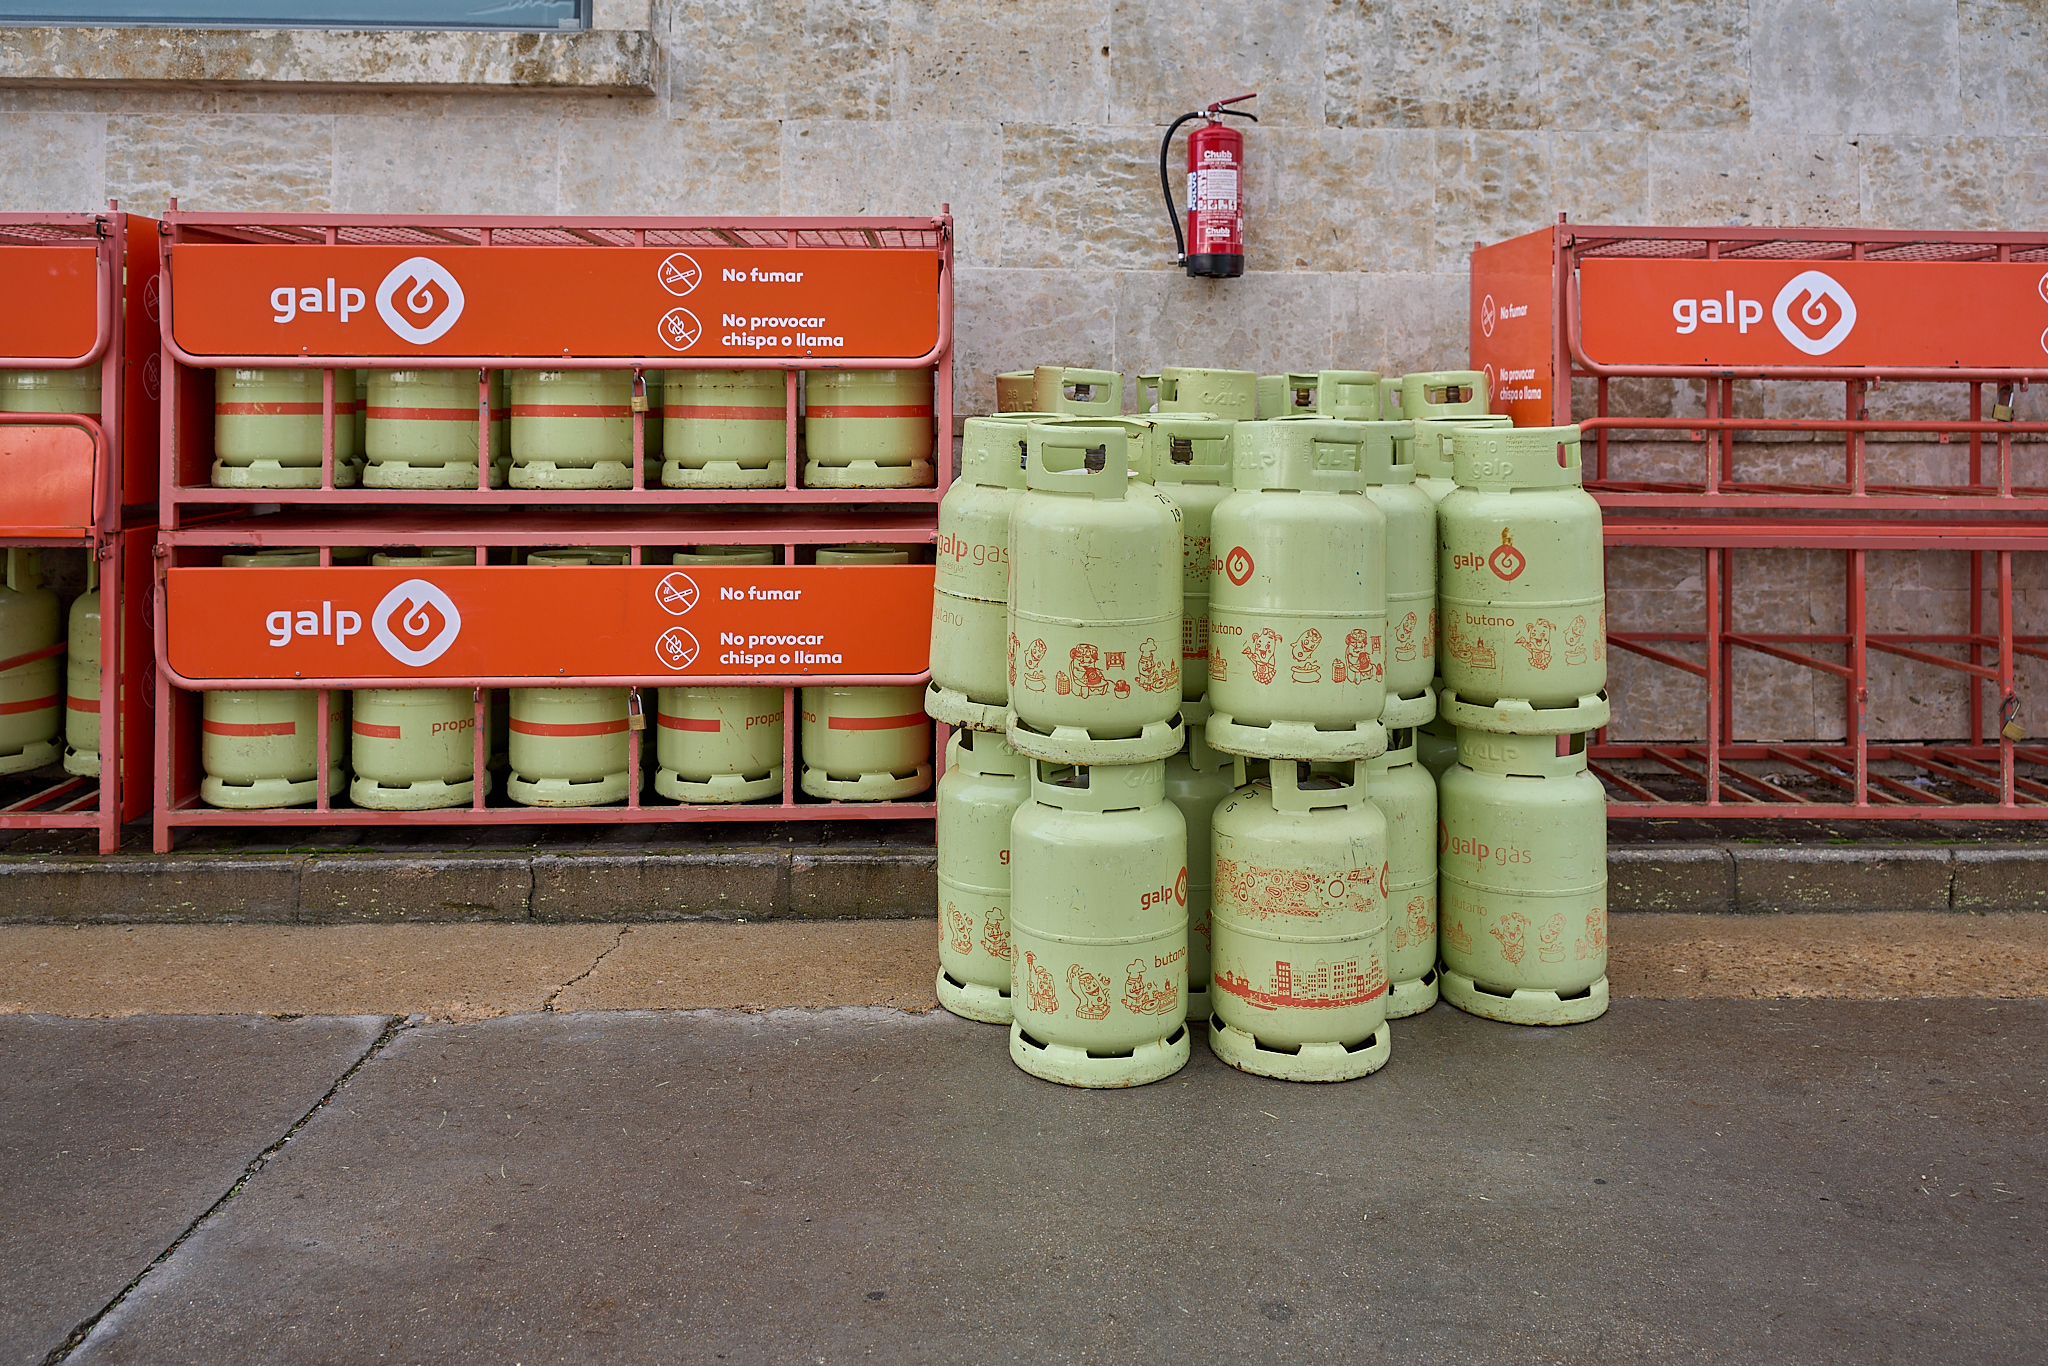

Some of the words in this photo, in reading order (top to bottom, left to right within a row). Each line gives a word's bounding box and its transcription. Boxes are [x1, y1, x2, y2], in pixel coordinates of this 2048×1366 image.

[1204, 150, 1232, 159] Chubb
[1206, 227, 1230, 235] Chubb
[723, 268, 746, 282] No
[750, 268, 803, 282] fumar
[271, 278, 365, 323] galp
[1500, 306, 1509, 319] No
[1509, 304, 1527, 318] fumar
[1673, 290, 1763, 334] galp
[723, 314, 746, 328] No
[751, 317, 825, 330] provocar
[722, 332, 777, 349] chispa
[781, 336, 792, 346] o
[797, 333, 843, 347] llama
[1500, 368, 1508, 381] No
[1509, 368, 1535, 383] provocar
[1199, 391, 1246, 406] GALP
[1500, 387, 1518, 403] chispa
[1524, 387, 1541, 400] llama
[1483, 440, 1498, 453] 10
[1234, 451, 1276, 470] ALP
[1472, 458, 1513, 479] galp
[938, 533, 968, 562] galp
[1453, 552, 1485, 571] galp
[721, 586, 744, 600] No
[748, 586, 802, 600] fumar
[266, 601, 361, 646] galp
[1212, 620, 1243, 636] butano
[1466, 612, 1515, 627] butano
[721, 632, 744, 646] No
[749, 635, 824, 648] provocar
[720, 650, 775, 667] chispa
[780, 654, 790, 664] o
[795, 651, 842, 664] llama
[432, 717, 475, 736] propa
[746, 710, 784, 730] propan
[1452, 837, 1489, 861] galp
[1495, 847, 1531, 866] gas
[1140, 886, 1172, 910] galp
[1452, 893, 1487, 916] butano
[1154, 946, 1186, 968] butano
